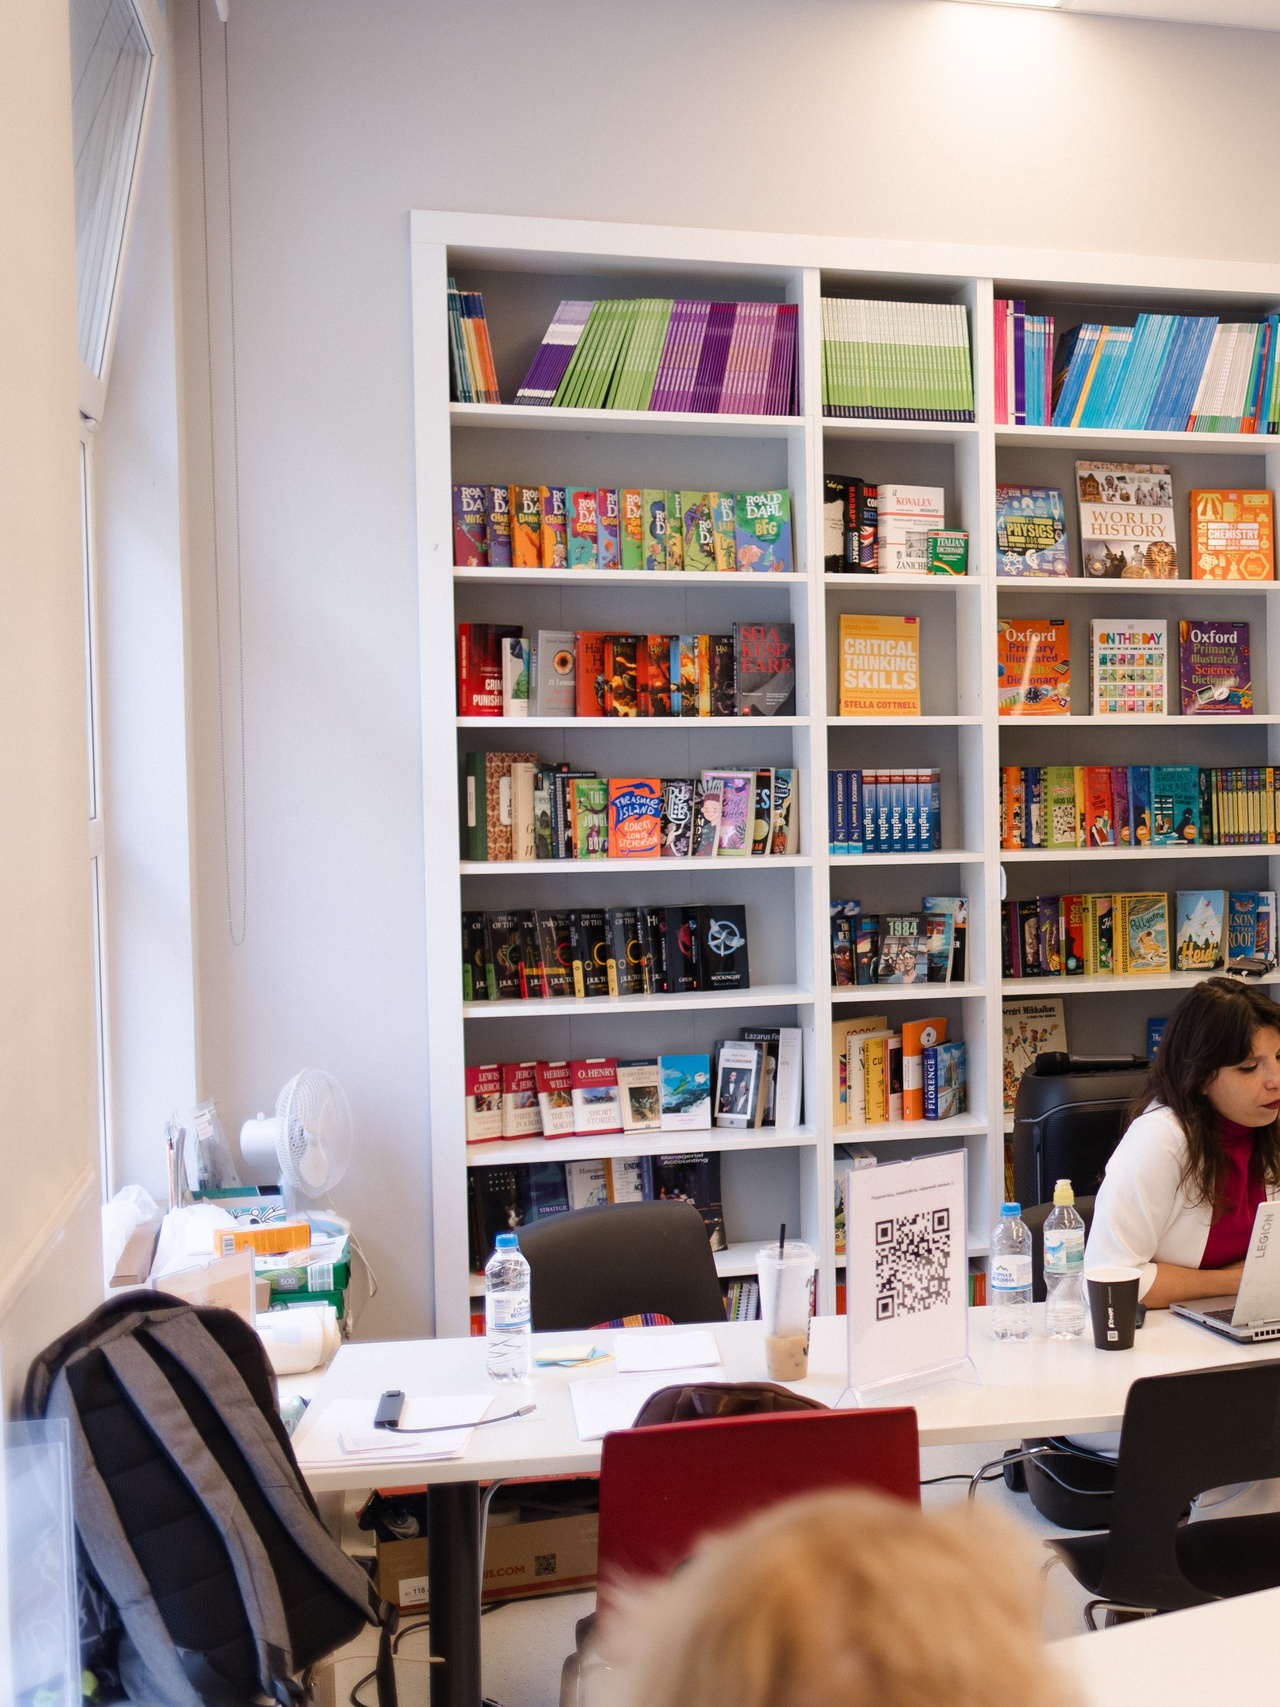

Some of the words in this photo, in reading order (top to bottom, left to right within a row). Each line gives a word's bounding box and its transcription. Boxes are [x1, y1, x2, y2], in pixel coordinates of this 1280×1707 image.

[746, 494, 782, 506] ROALD
[896, 496, 932, 506] KOVALEV
[747, 505, 782, 518] DAHL
[1092, 511, 1163, 525] WORLD
[755, 519, 778, 536] BFG
[1006, 524, 1054, 538] PHYSICS
[1091, 524, 1166, 538] HISTORY
[1208, 529, 1259, 540] CHEMISTRY
[937, 538, 965, 547] ITALIAN
[937, 546, 964, 554] DICTIONARY
[741, 627, 779, 642] SHA
[1006, 628, 1056, 642] Oxford
[1098, 632, 1116, 645] ON
[1116, 632, 1141, 645] THIS
[1142, 632, 1162, 645] DAY
[1190, 630, 1238, 643] Oxford
[742, 643, 788, 658] KESP
[844, 638, 916, 656] CRITICAL
[1194, 644, 1236, 656] Primary
[742, 658, 792, 673] EARE
[844, 654, 916, 672] THINKING
[1192, 655, 1238, 664] Illustrated
[1195, 664, 1236, 674] Science
[844, 670, 916, 690] SKILLS
[844, 700, 874, 708] STELLA
[876, 701, 917, 709] COTTRELL
[1155, 772, 1198, 783] SHERLOCK
[590, 791, 604, 804] THE
[864, 808, 874, 840] English
[878, 808, 889, 840] English
[1130, 912, 1166, 932] Pollyanna
[889, 922, 918, 936] 1984
[1182, 942, 1217, 963] Heidi
[1022, 1005, 1056, 1014] Mikhalkov
[745, 1032, 771, 1040] Lazarus
[478, 1071, 500, 1082] LEWIS
[578, 1070, 588, 1078] O.
[588, 1068, 615, 1078] HENRY
[512, 1082, 518, 1090] K.
[550, 1078, 572, 1088] WELLS
[588, 1108, 613, 1116] SHORT
[586, 1116, 616, 1125] STORIES
[661, 1152, 704, 1160] Managerial
[664, 1158, 708, 1166] Accounting
[1255, 1214, 1274, 1259] LEGION
[280, 1277, 296, 1286] 500
[413, 1586, 426, 1596] 118
